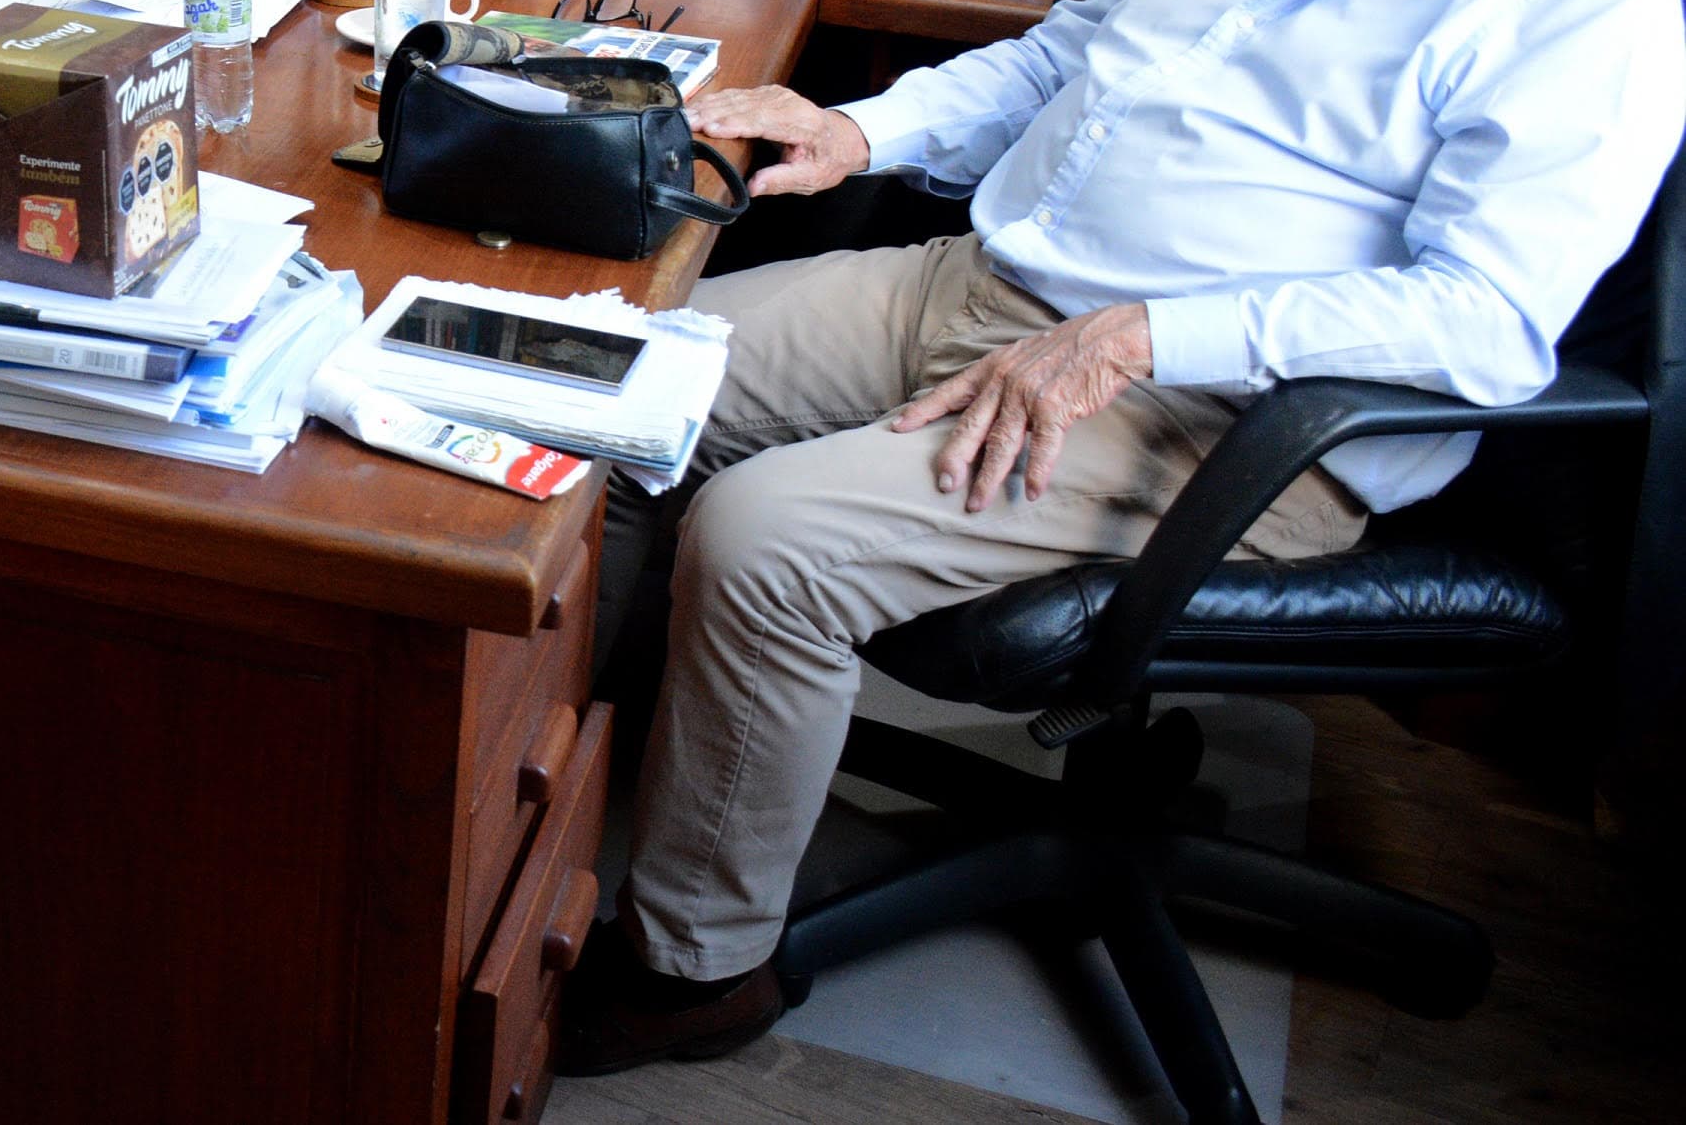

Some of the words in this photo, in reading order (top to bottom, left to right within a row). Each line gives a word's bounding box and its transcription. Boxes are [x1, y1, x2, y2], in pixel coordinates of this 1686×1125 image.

[2, 20, 96, 50] Tommy
[115, 58, 190, 125] Tommy
[134, 99, 173, 131] PANETTONE
[19, 154, 81, 171] Experimente
[24, 199, 62, 221] Tommy
[521, 450, 563, 489] Colgate
